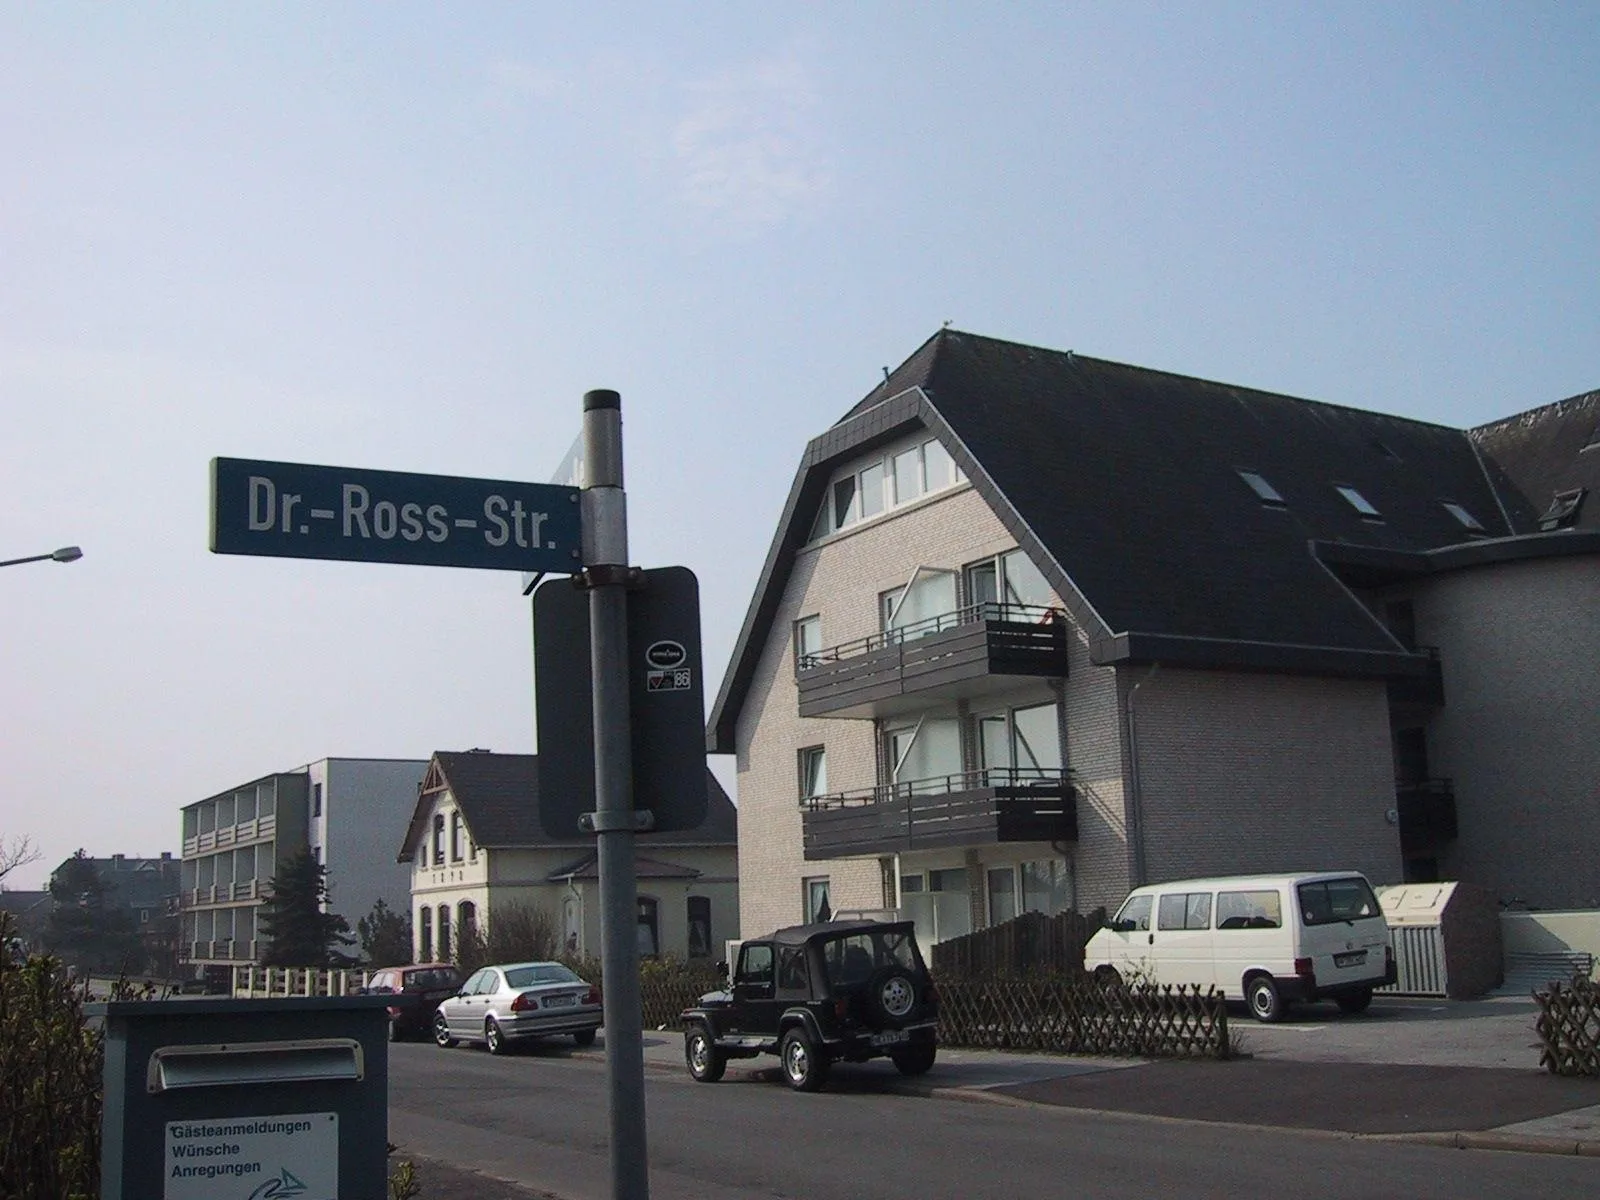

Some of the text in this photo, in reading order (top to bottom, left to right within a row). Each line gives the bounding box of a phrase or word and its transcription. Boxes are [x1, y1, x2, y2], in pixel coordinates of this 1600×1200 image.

[249, 476, 556, 550] Dr.-Ross-Str.
[172, 1120, 311, 1139] Gästeanmeldungen
[172, 1143, 240, 1158] Wünsche
[171, 1161, 261, 1178] Anregungen
